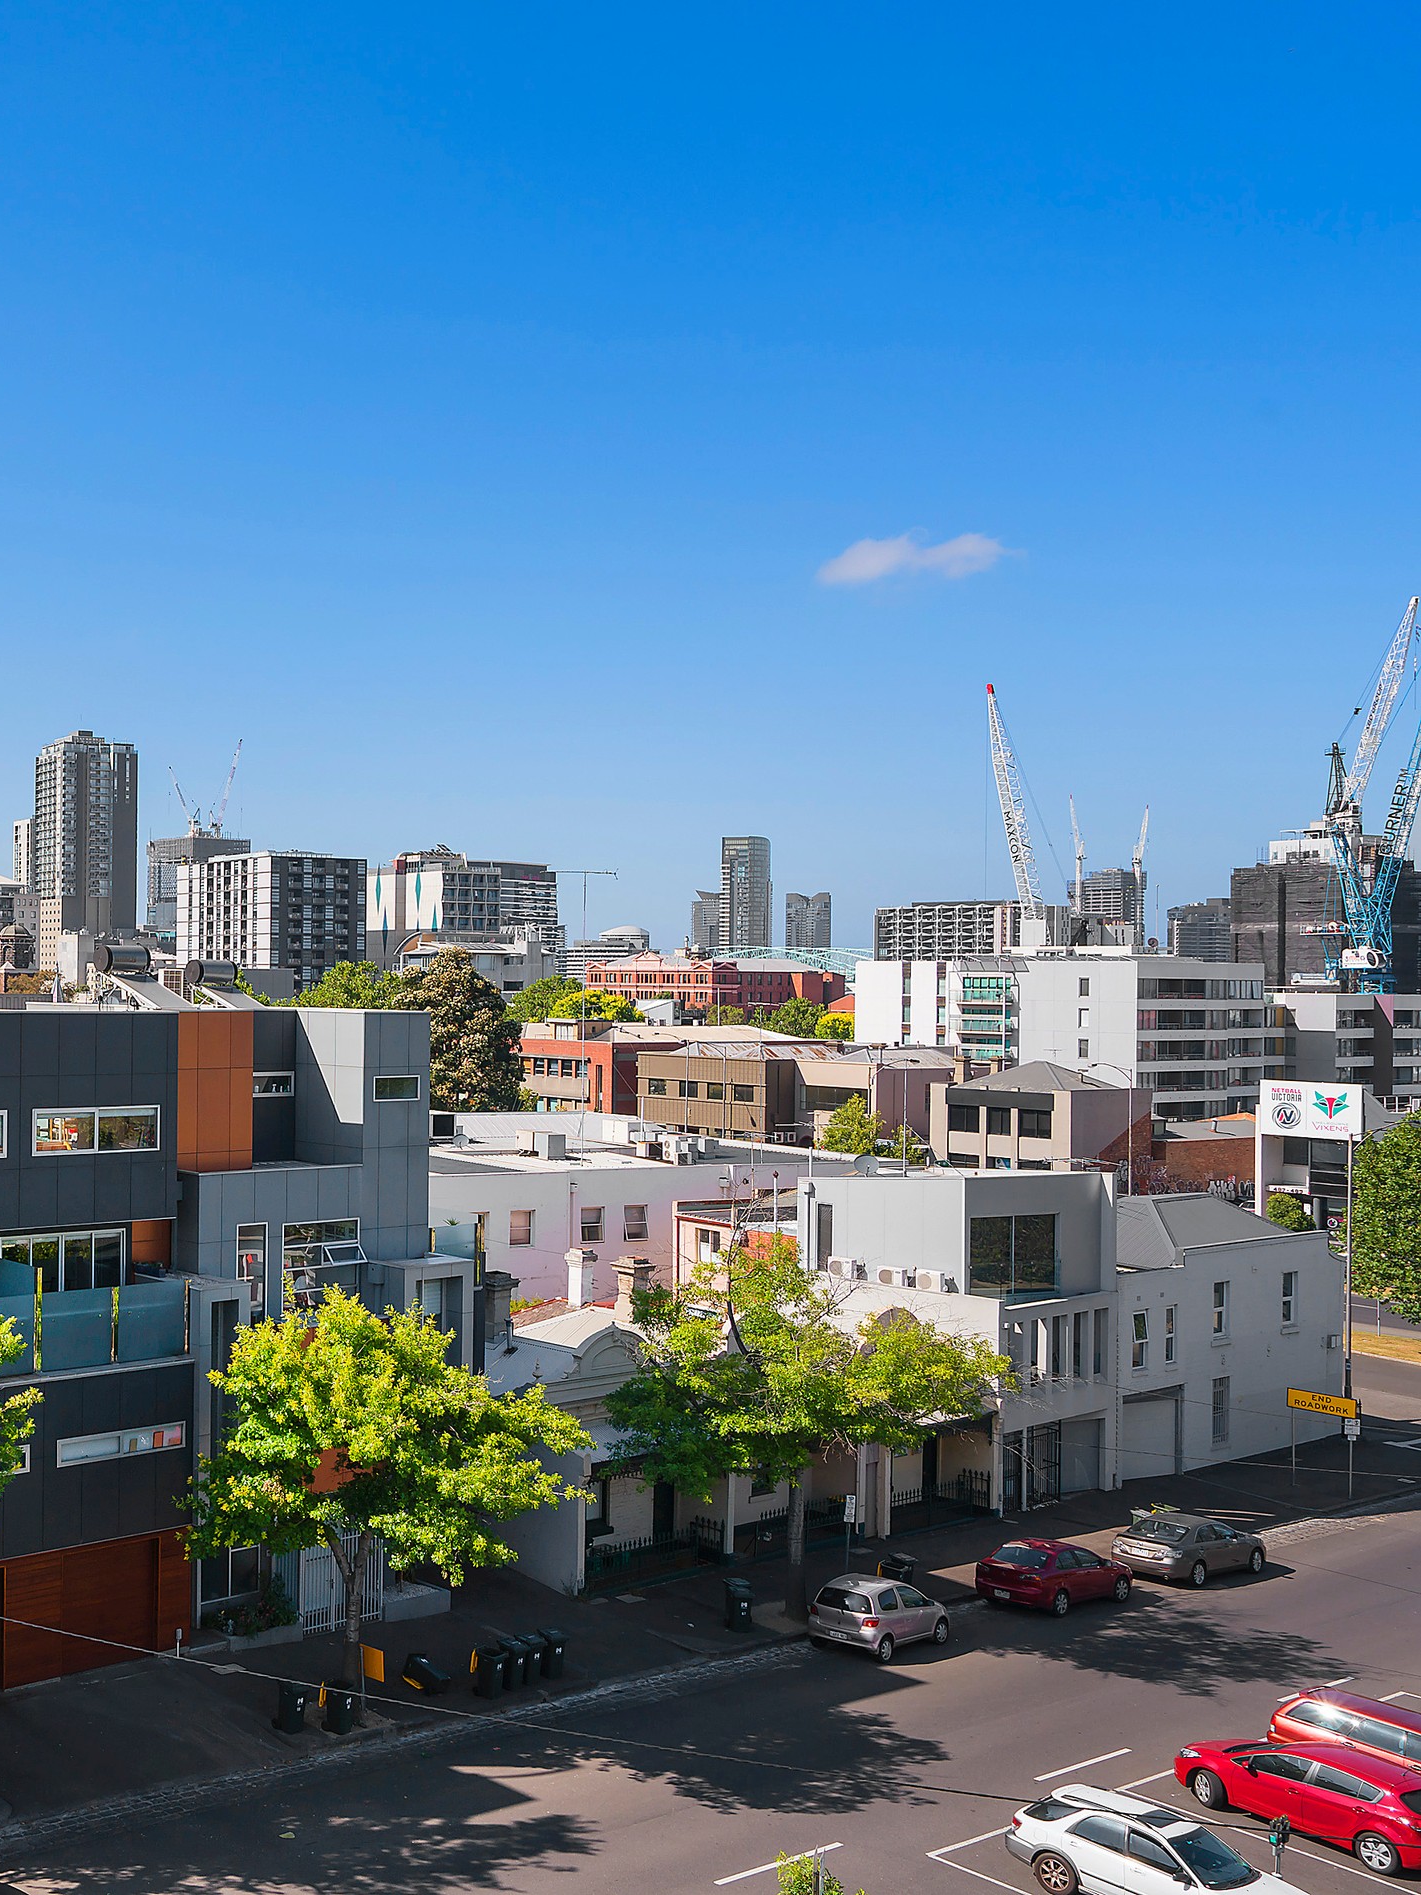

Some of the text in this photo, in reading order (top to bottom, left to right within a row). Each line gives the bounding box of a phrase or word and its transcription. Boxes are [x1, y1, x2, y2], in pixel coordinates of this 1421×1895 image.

[1004, 810, 1021, 863] MAXCON
[1271, 1093, 1302, 1102] VICTORIA
[1312, 1121, 1349, 1133] VIXENS
[1312, 1394, 1332, 1404] END
[1294, 1399, 1349, 1415] ROADWORK
